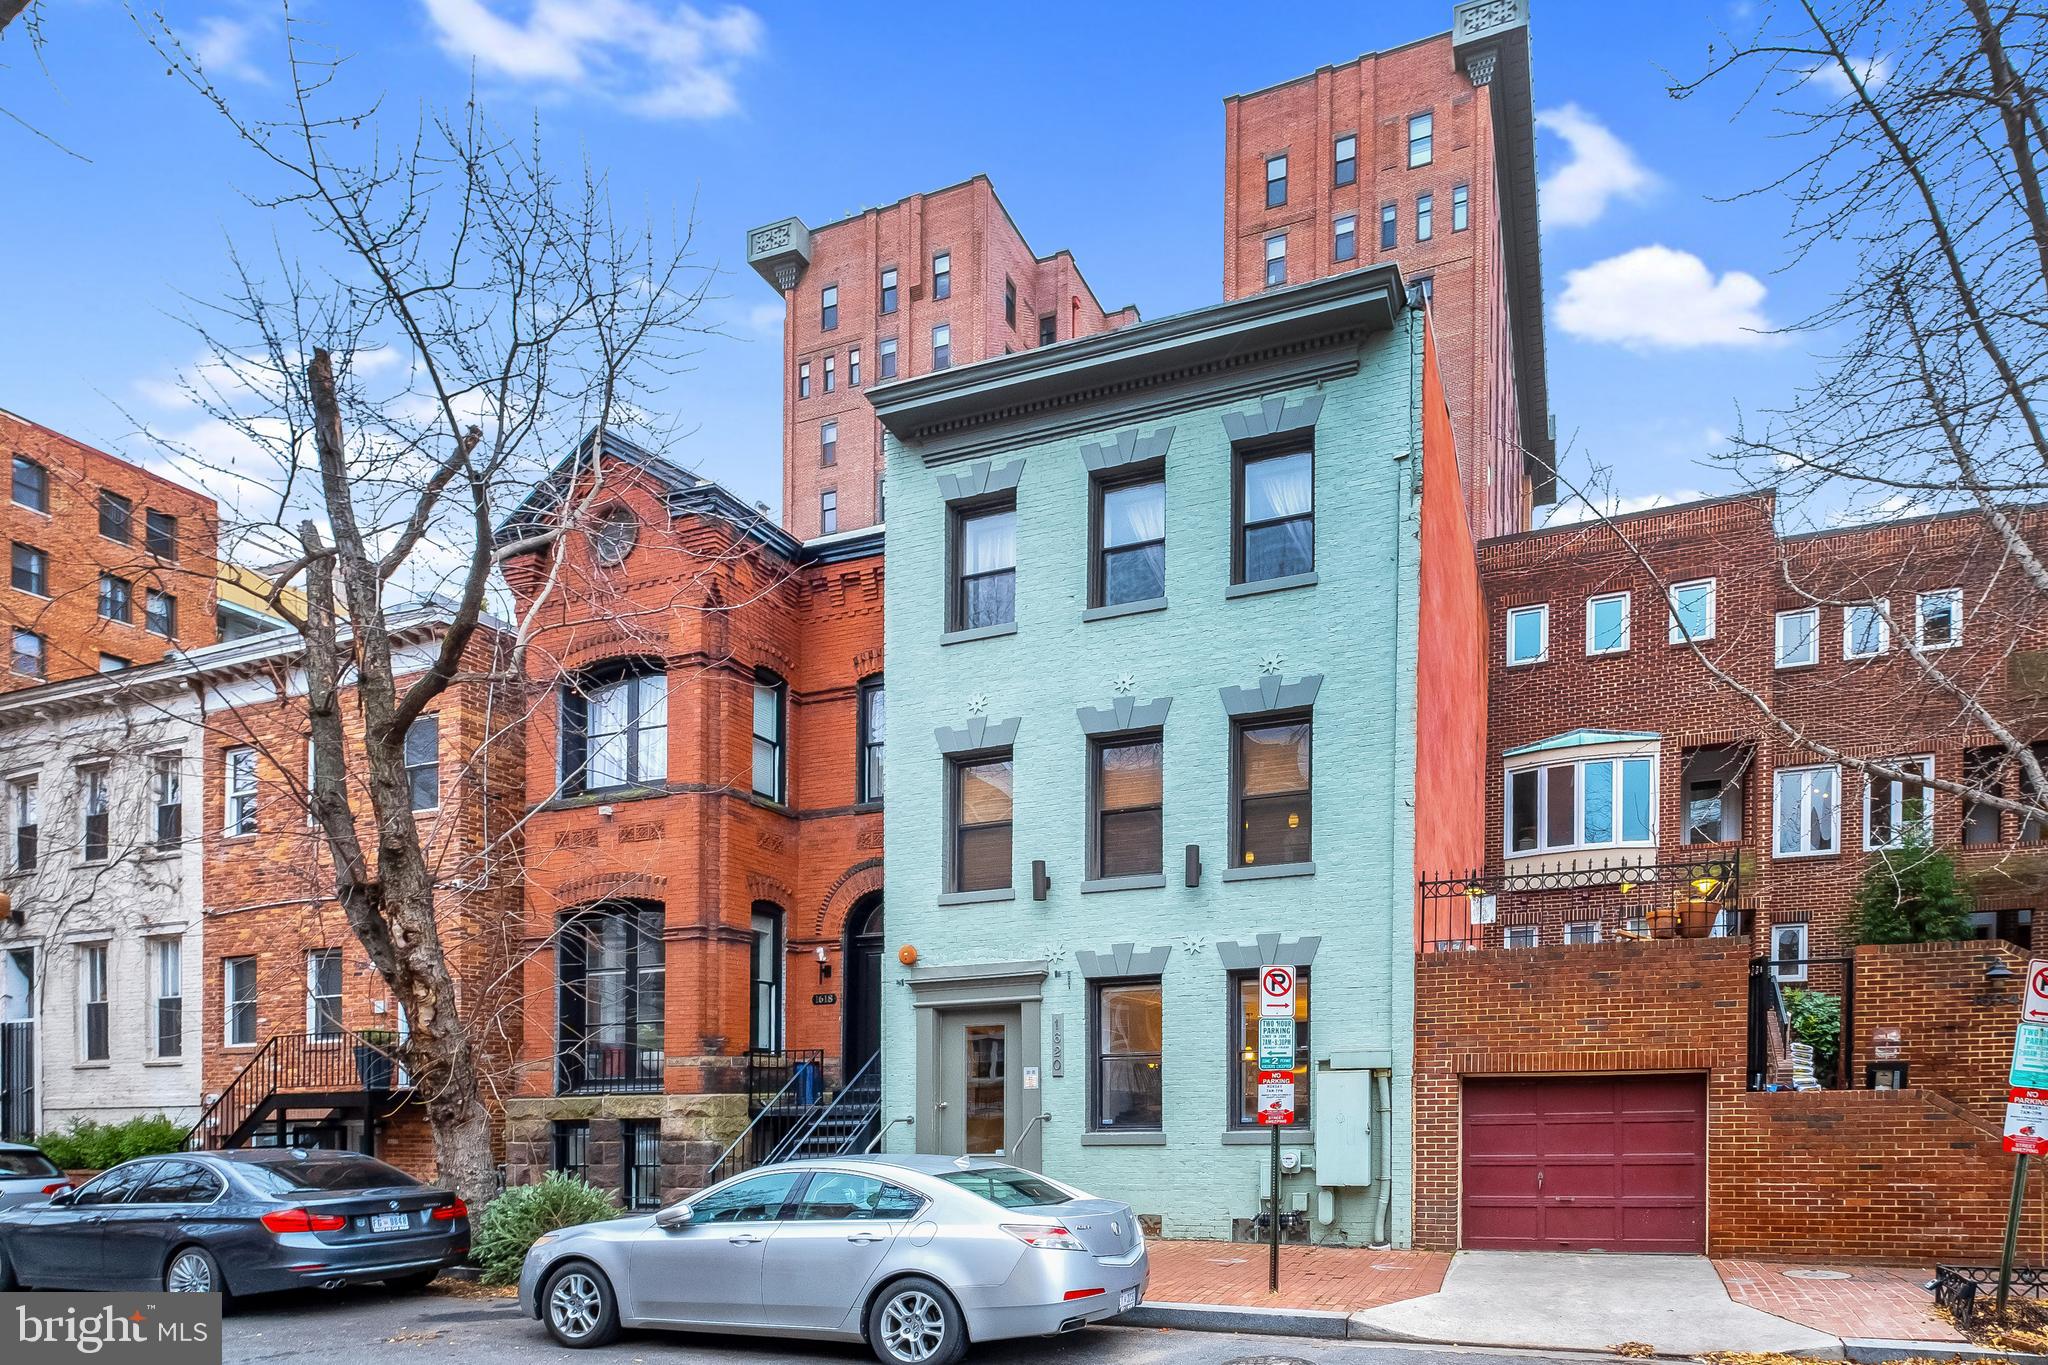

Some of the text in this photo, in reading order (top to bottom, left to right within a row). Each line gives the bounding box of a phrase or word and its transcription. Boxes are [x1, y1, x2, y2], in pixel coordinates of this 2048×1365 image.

[2023, 1028, 2039, 1037] TWO
[1053, 1019, 1061, 1071] 1620
[1271, 1057, 1279, 1065] 2
